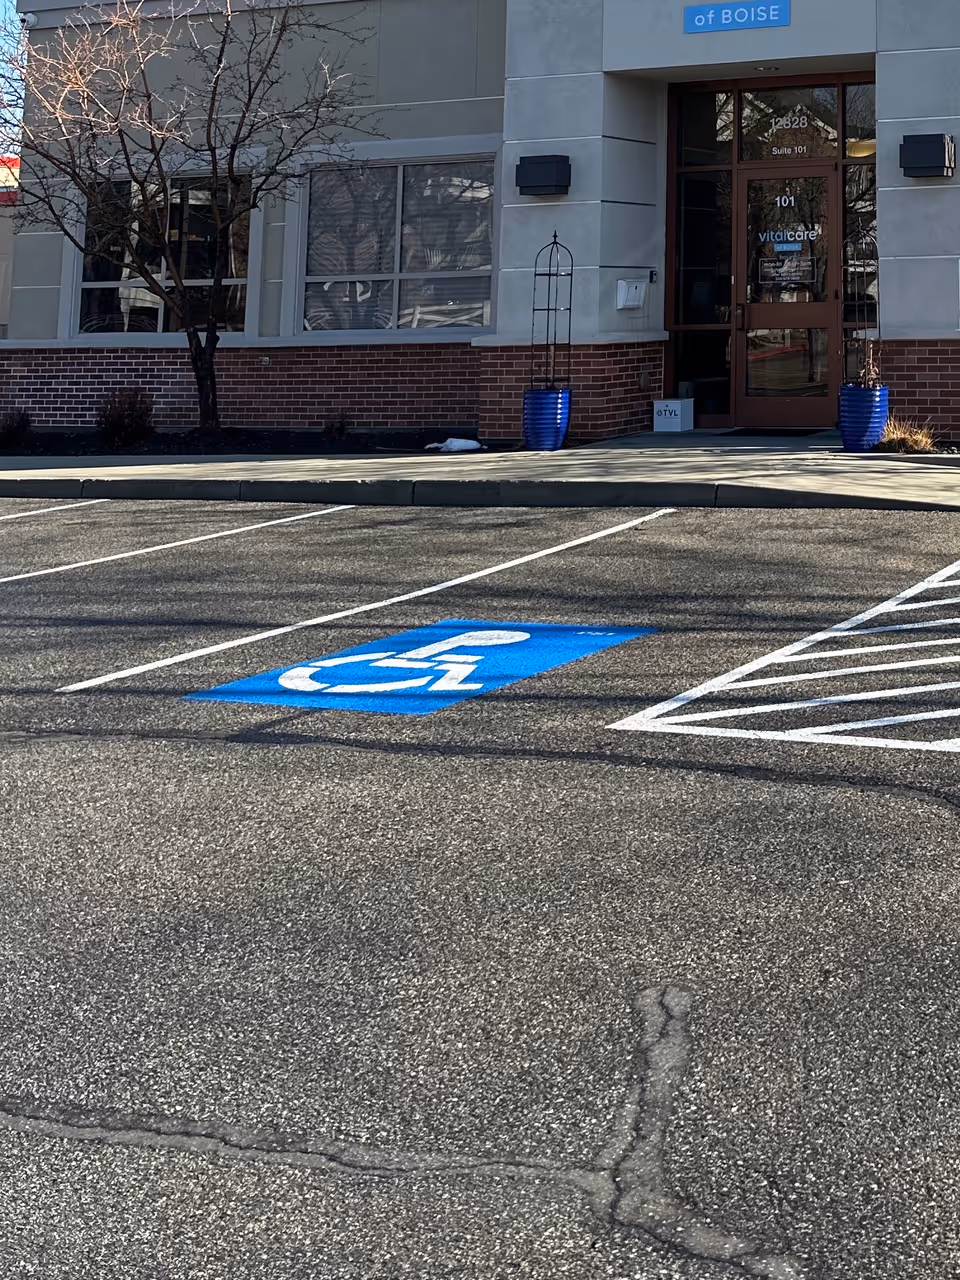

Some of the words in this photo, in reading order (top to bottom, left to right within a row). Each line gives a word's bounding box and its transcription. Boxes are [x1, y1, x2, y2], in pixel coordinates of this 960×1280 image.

[695, 10, 715, 26] of
[721, 5, 780, 24] BOISE
[770, 116, 808, 129] 12828
[772, 147, 792, 155] Suite
[794, 145, 807, 153] 101
[775, 195, 795, 207] 101
